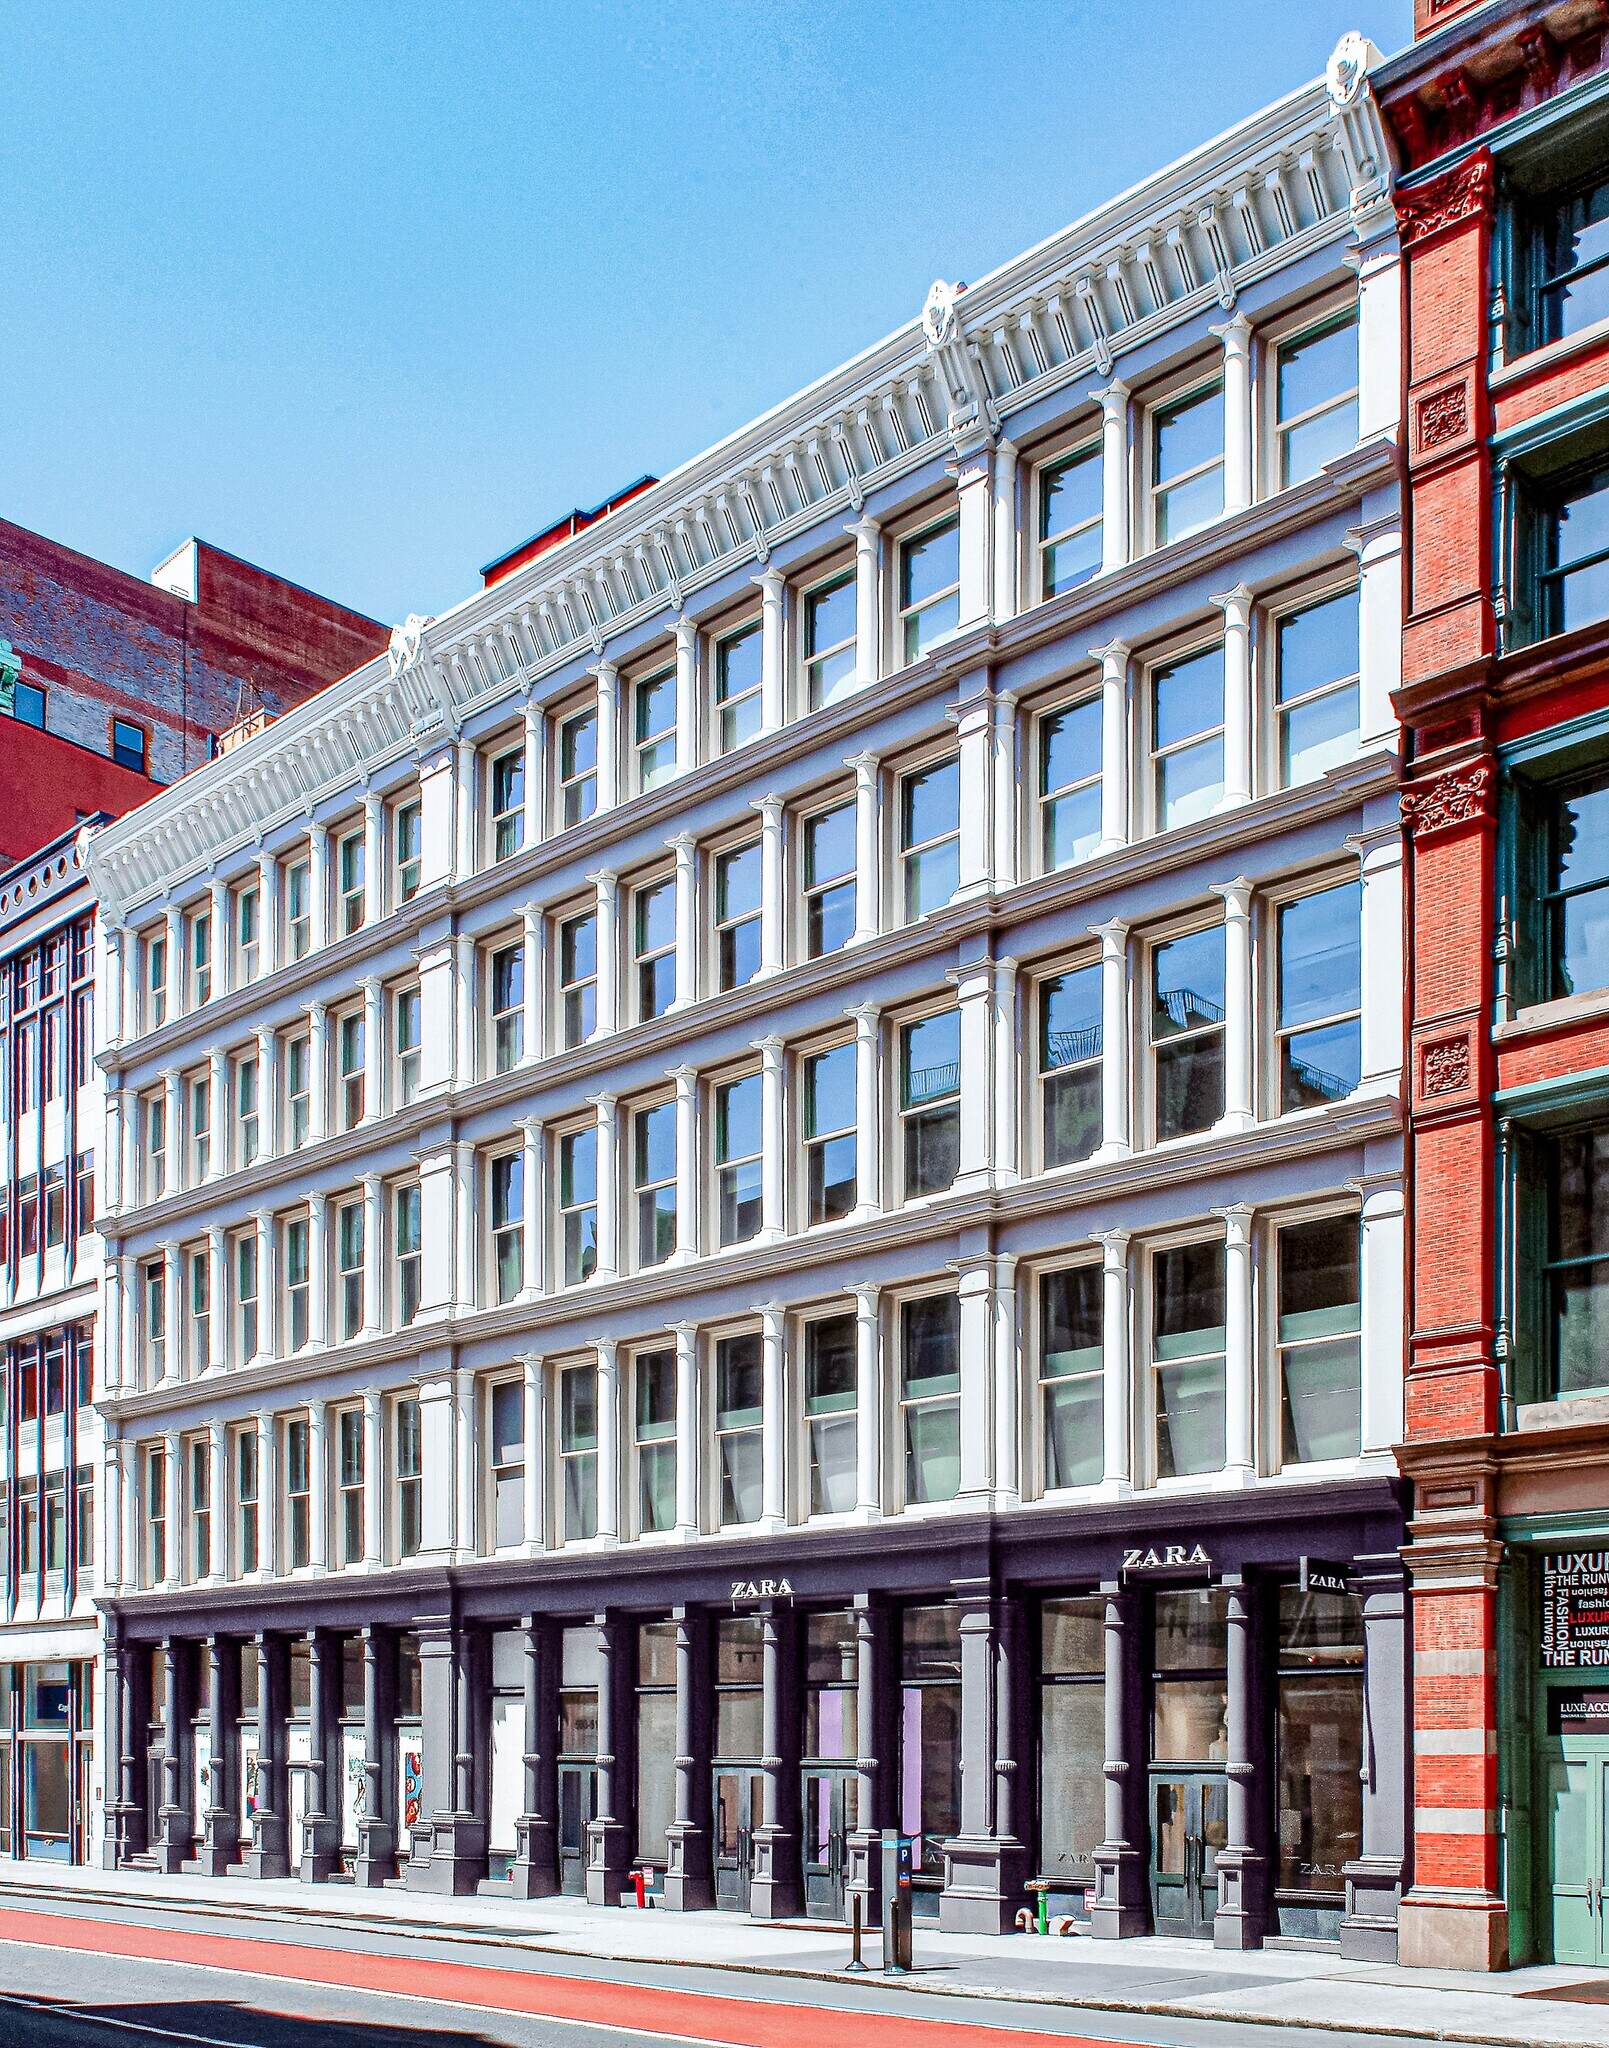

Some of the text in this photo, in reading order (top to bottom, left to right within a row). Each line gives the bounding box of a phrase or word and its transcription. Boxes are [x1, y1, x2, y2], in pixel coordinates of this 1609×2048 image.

[1122, 1544, 1212, 1568] ZARA
[1310, 1574, 1345, 1589] ZARA
[1556, 1573, 1609, 1586] THE RUN
[731, 1578, 796, 1598] ZARA
[1571, 1587, 1608, 1597] fashion
[1541, 1601, 1554, 1650] runway
[1557, 1589, 1569, 1650] FASHION
[1543, 1651, 1575, 1666] THE
[901, 1849, 909, 1862] P
[1058, 1852, 1092, 1863] ZAR
[1300, 1863, 1343, 1876] ZAR
